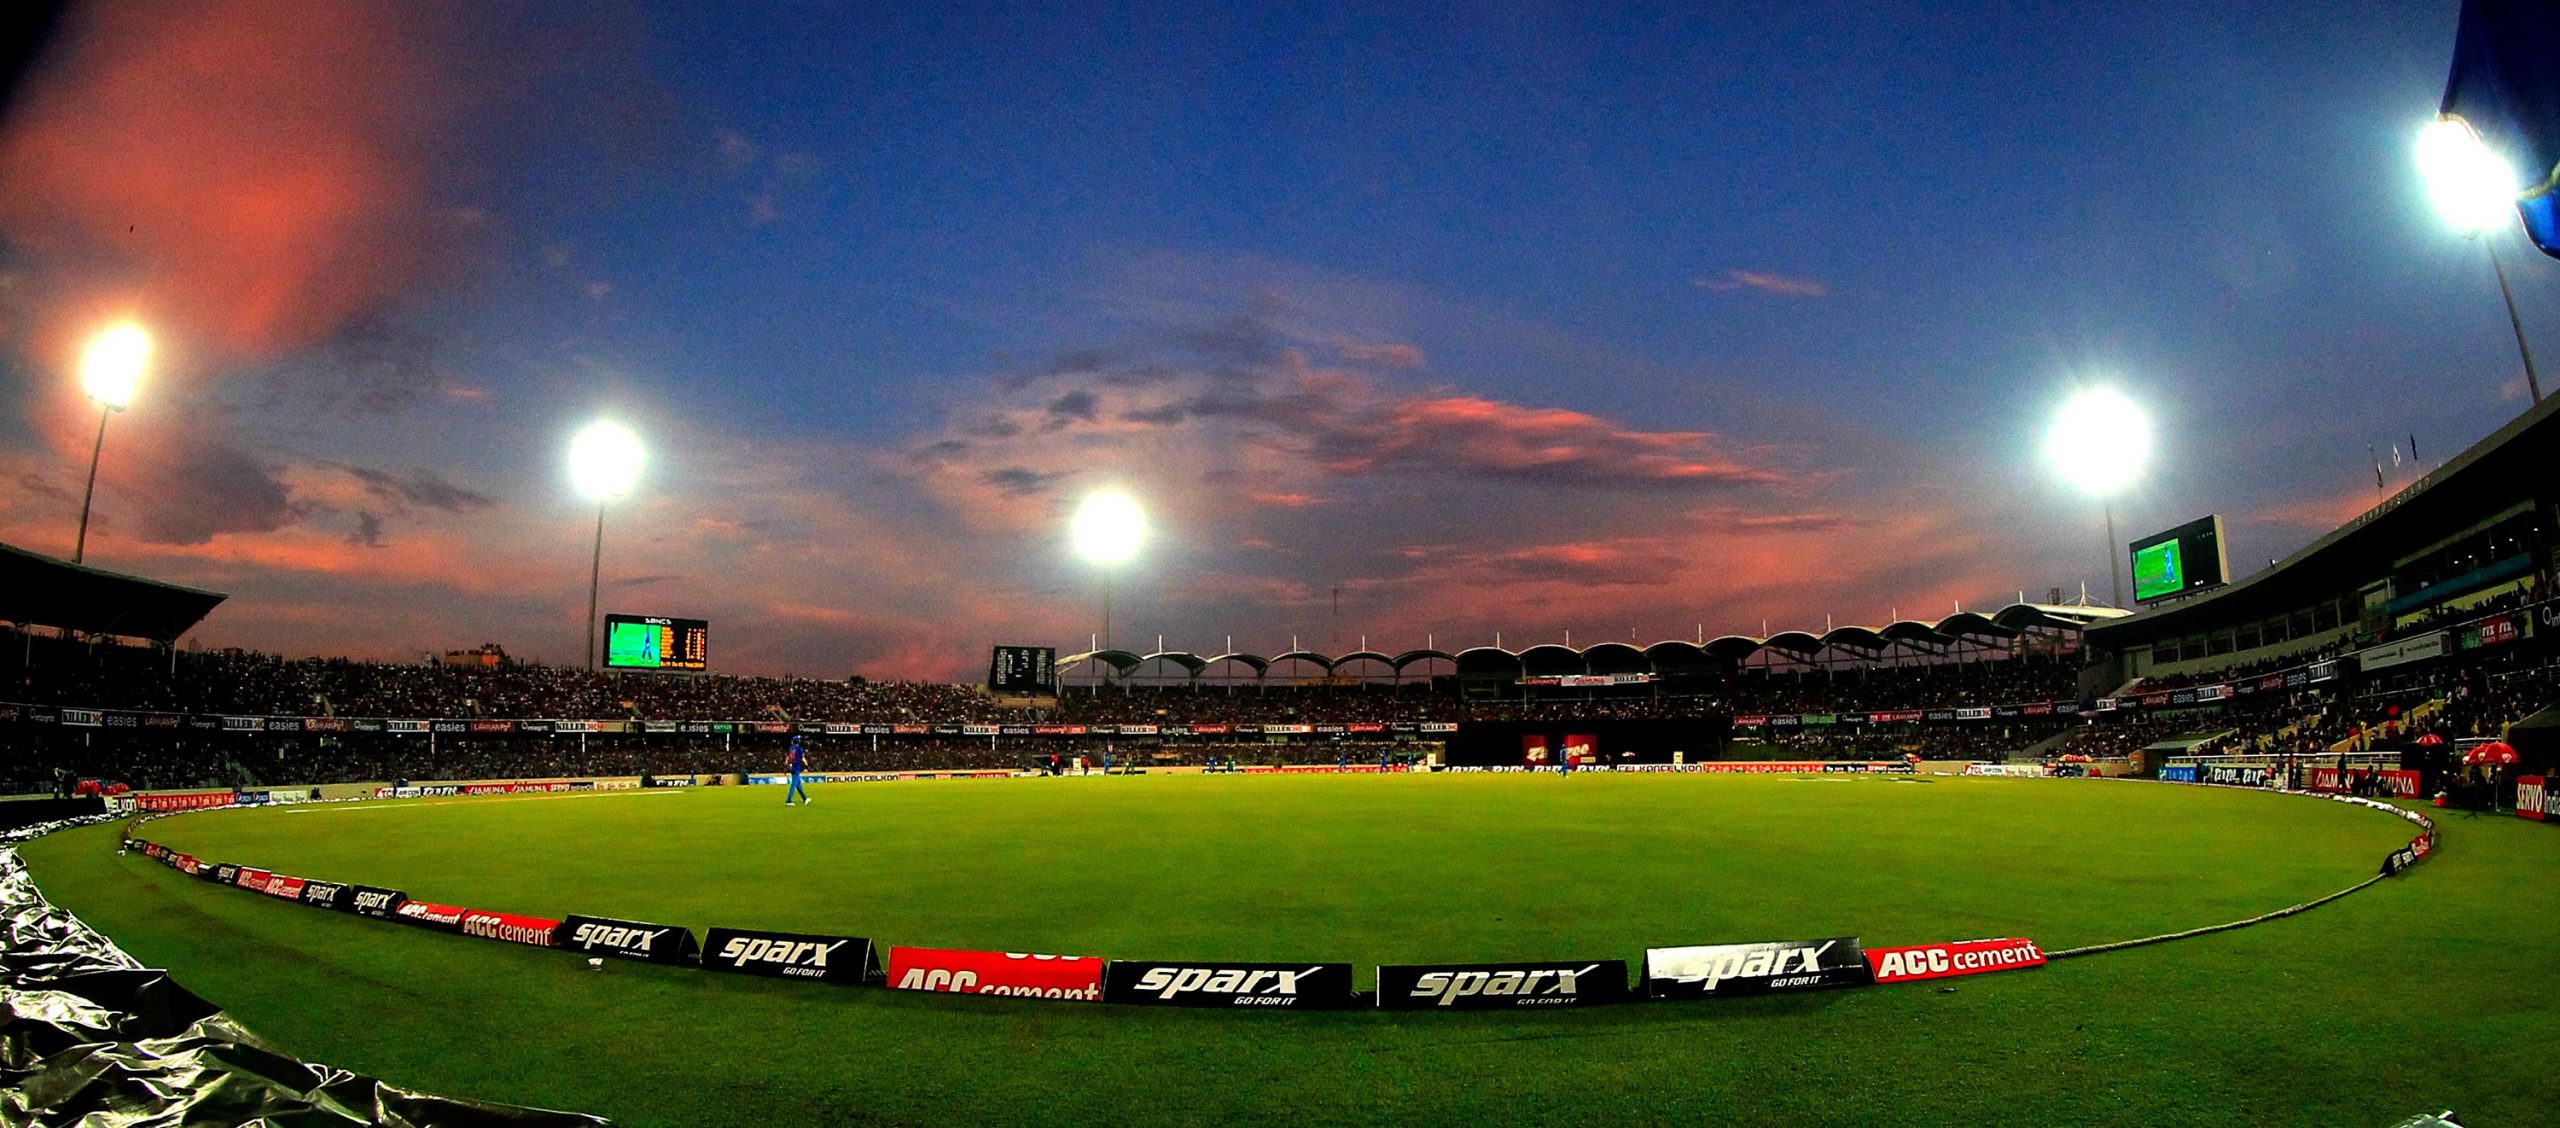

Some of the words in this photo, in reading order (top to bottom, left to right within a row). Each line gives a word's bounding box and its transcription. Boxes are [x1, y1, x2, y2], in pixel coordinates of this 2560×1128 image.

[2516, 783, 2543, 812] SERVO
[306, 884, 341, 903] sparx
[354, 890, 396, 911] sparx
[463, 914, 502, 939] ACC
[498, 924, 553, 947] cement
[572, 922, 671, 952] sparx
[719, 936, 849, 967] sparx
[1675, 939, 1837, 991] sparx
[1876, 949, 1950, 979] ACC
[1952, 941, 2043, 973] cement
[783, 966, 796, 976] GO
[796, 967, 814, 977] FOR
[814, 968, 826, 978] IT
[897, 968, 978, 993] ACC
[1133, 965, 1323, 1000] sparx
[1409, 964, 1600, 1006] sparx
[1770, 978, 1787, 988] GO
[1787, 976, 1810, 986] FOR
[1810, 975, 1822, 985] IT
[1233, 996, 1254, 1005] GO
[1254, 996, 1280, 1005] FOR
[1280, 997, 1297, 1006] IT
